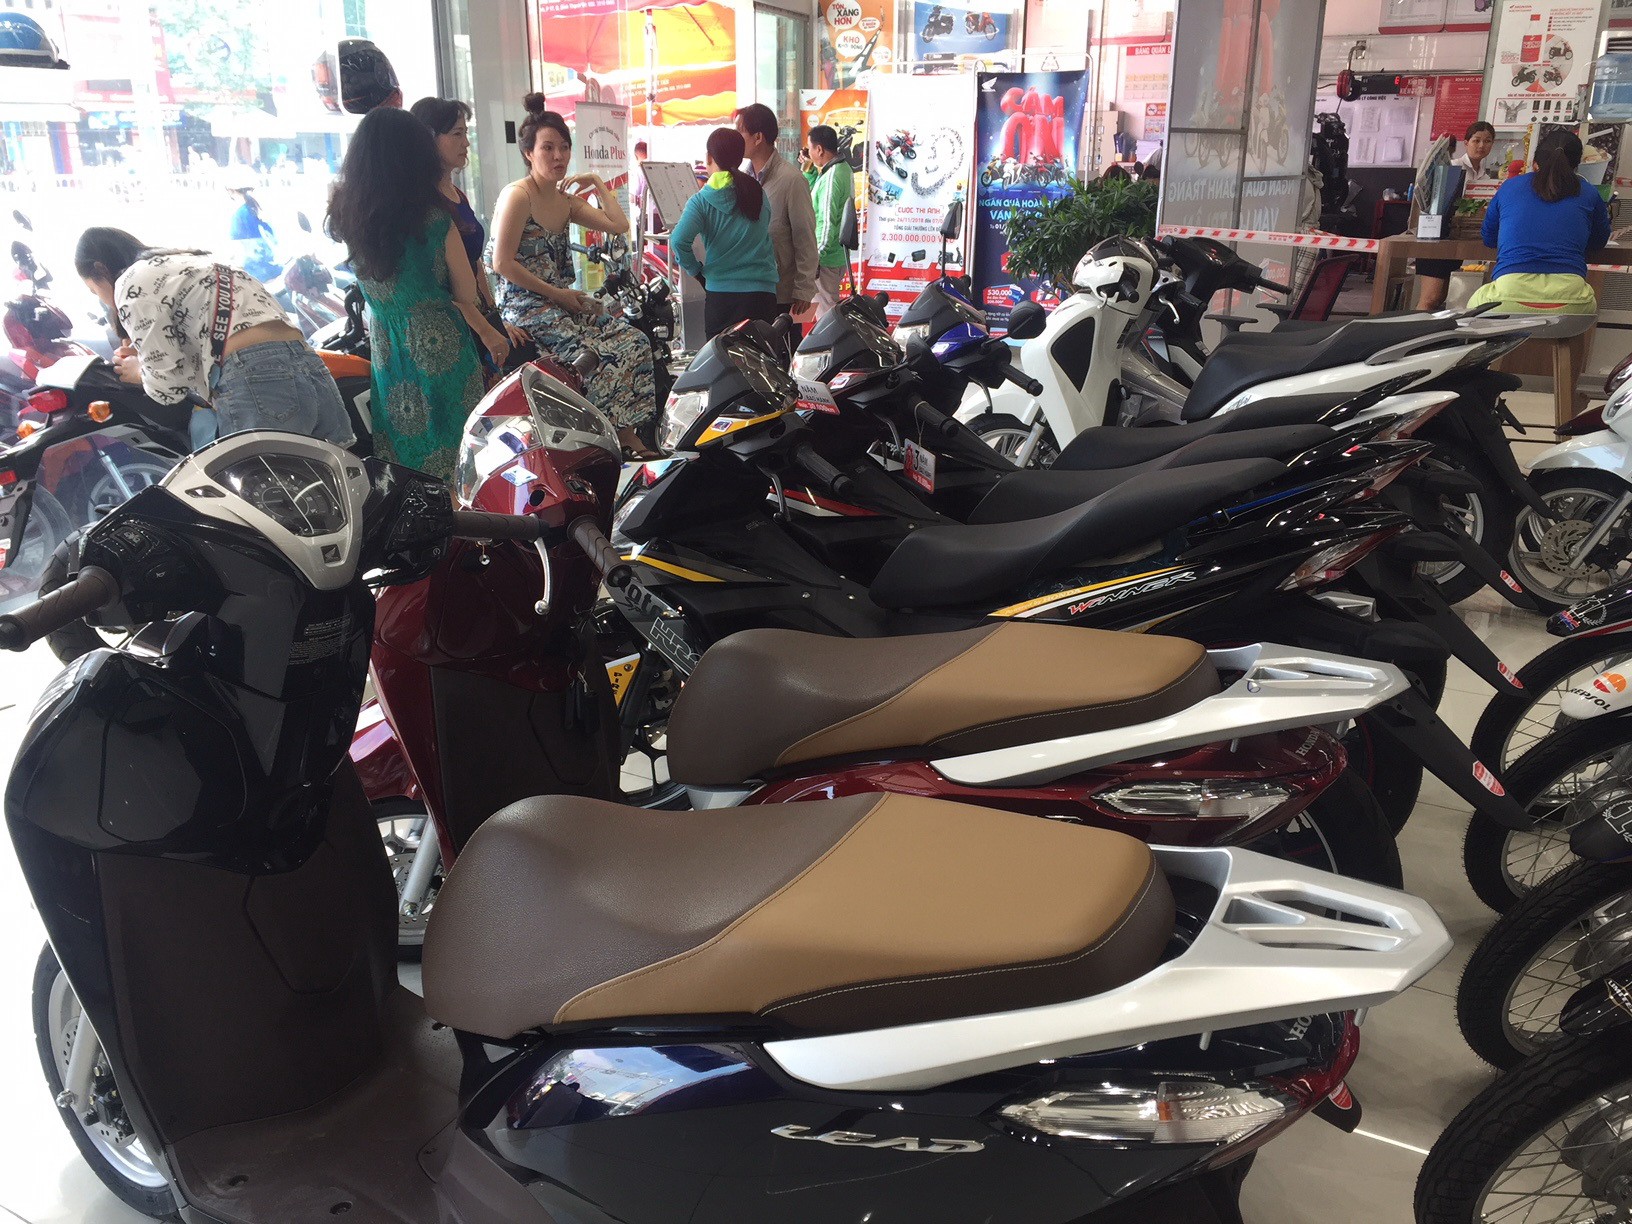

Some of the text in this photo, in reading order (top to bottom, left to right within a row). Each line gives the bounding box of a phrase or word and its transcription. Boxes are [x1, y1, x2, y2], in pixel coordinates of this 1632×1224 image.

[584, 145, 626, 160] Honda Plus
[217, 290, 232, 313] YOU
[214, 315, 229, 341] SEE
[1044, 588, 1083, 603] HONDA
[1067, 571, 1197, 616] WINNER
[1570, 687, 1612, 712] REPSOL
[770, 1124, 985, 1153] LEAD
